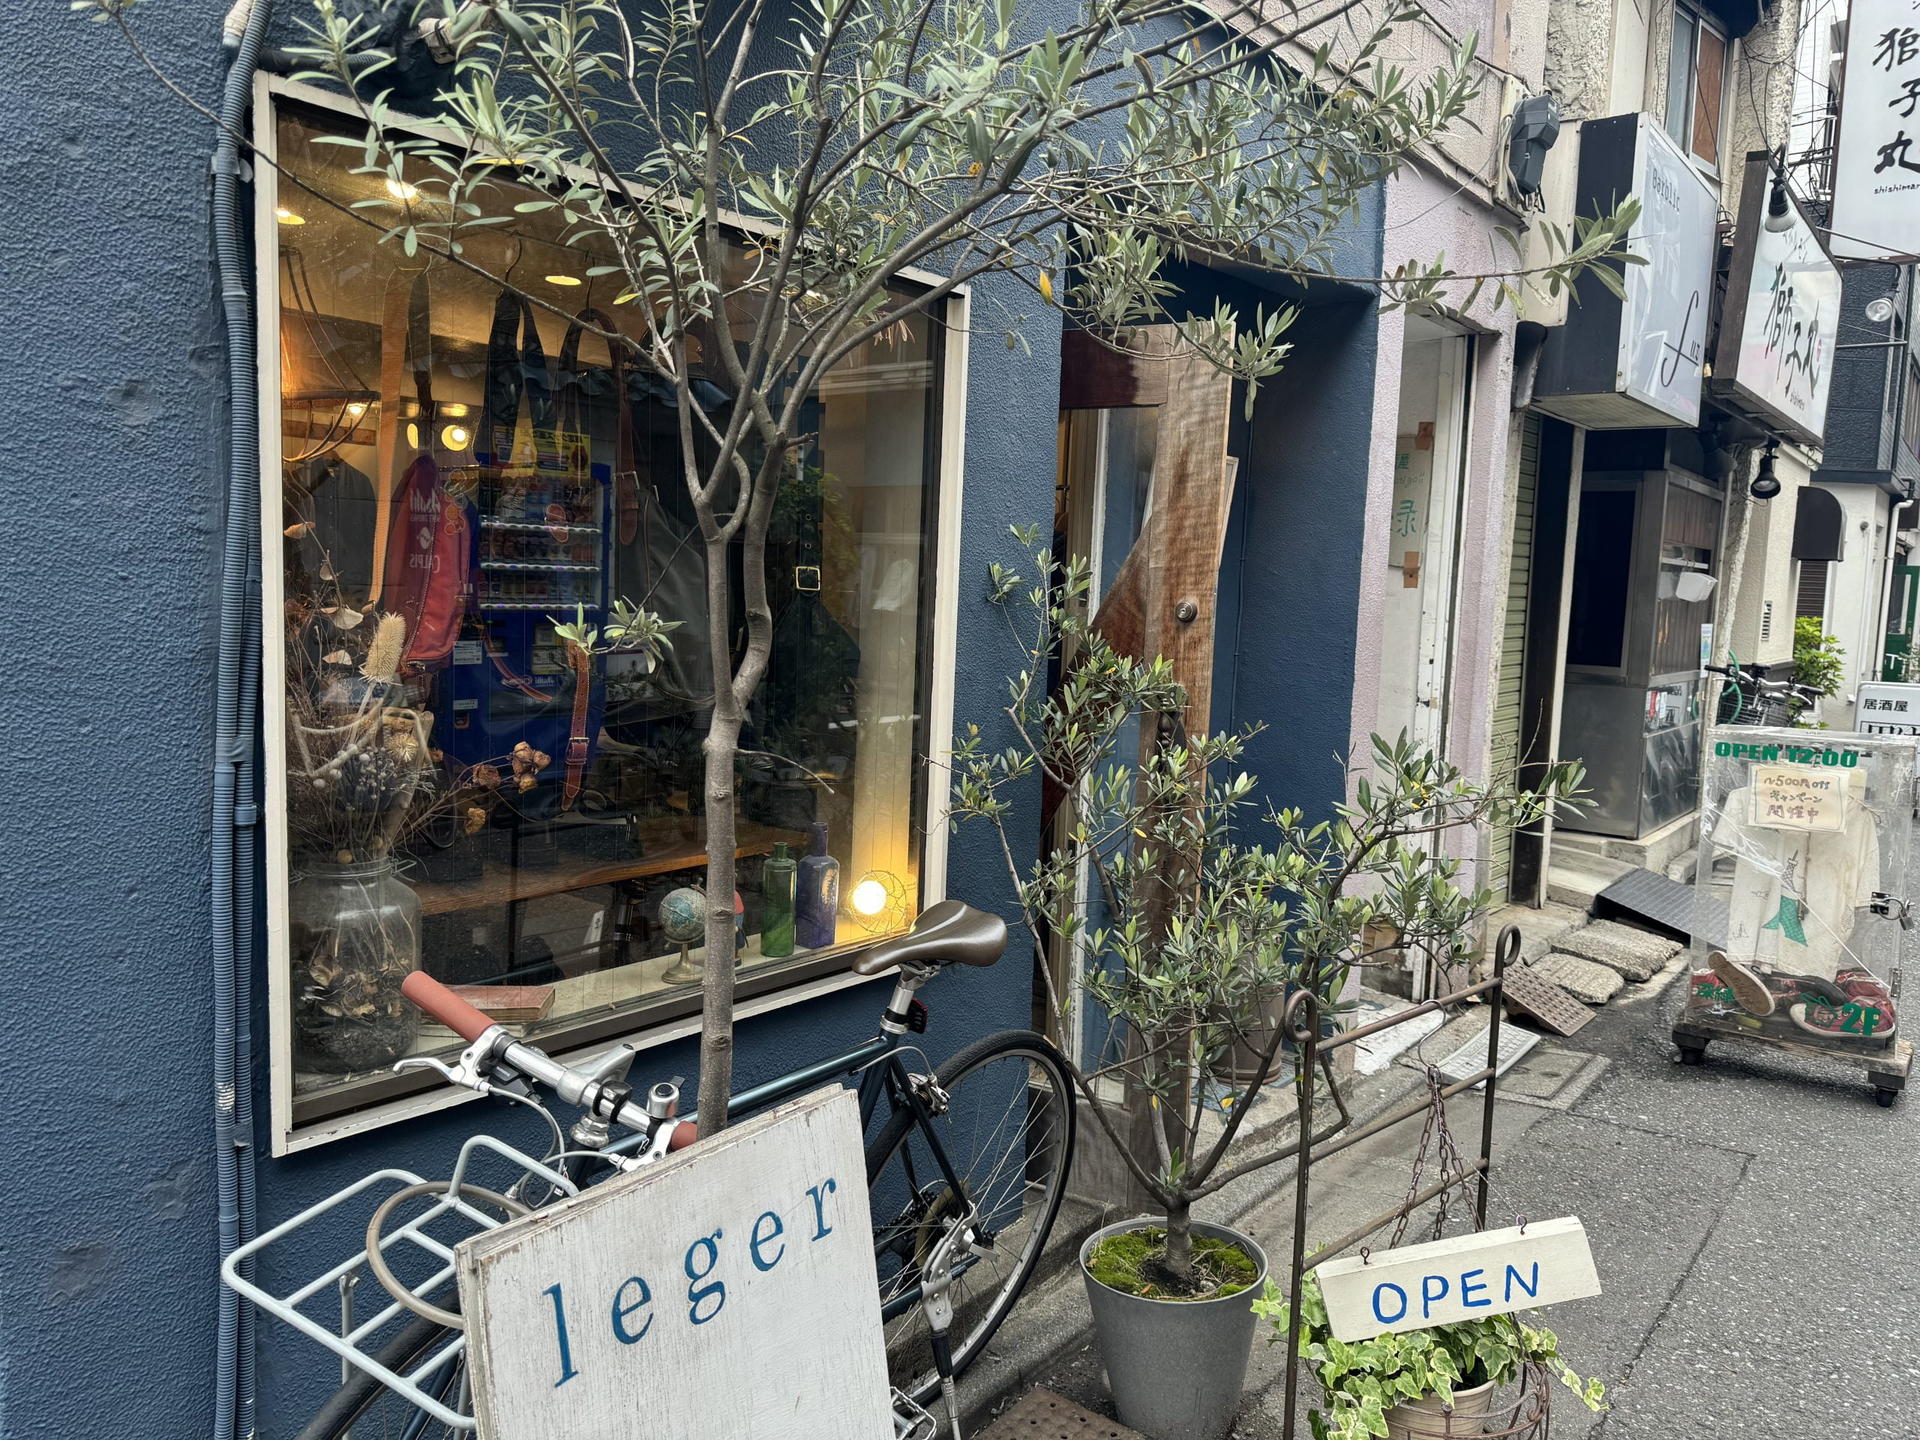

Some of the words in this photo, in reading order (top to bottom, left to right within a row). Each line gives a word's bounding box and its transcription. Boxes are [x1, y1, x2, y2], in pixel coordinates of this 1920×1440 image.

[1763, 262, 1822, 400] 獅子丸
[1863, 698, 1909, 712] 居酒屋
[1715, 741, 1779, 761] OPEN
[1788, 747, 1858, 768] 12:00
[1769, 790, 1823, 803] キャンペーン
[1840, 1002, 1881, 1036] 2F
[542, 1177, 838, 1388] leger
[1372, 1261, 1539, 1324] OPEN
